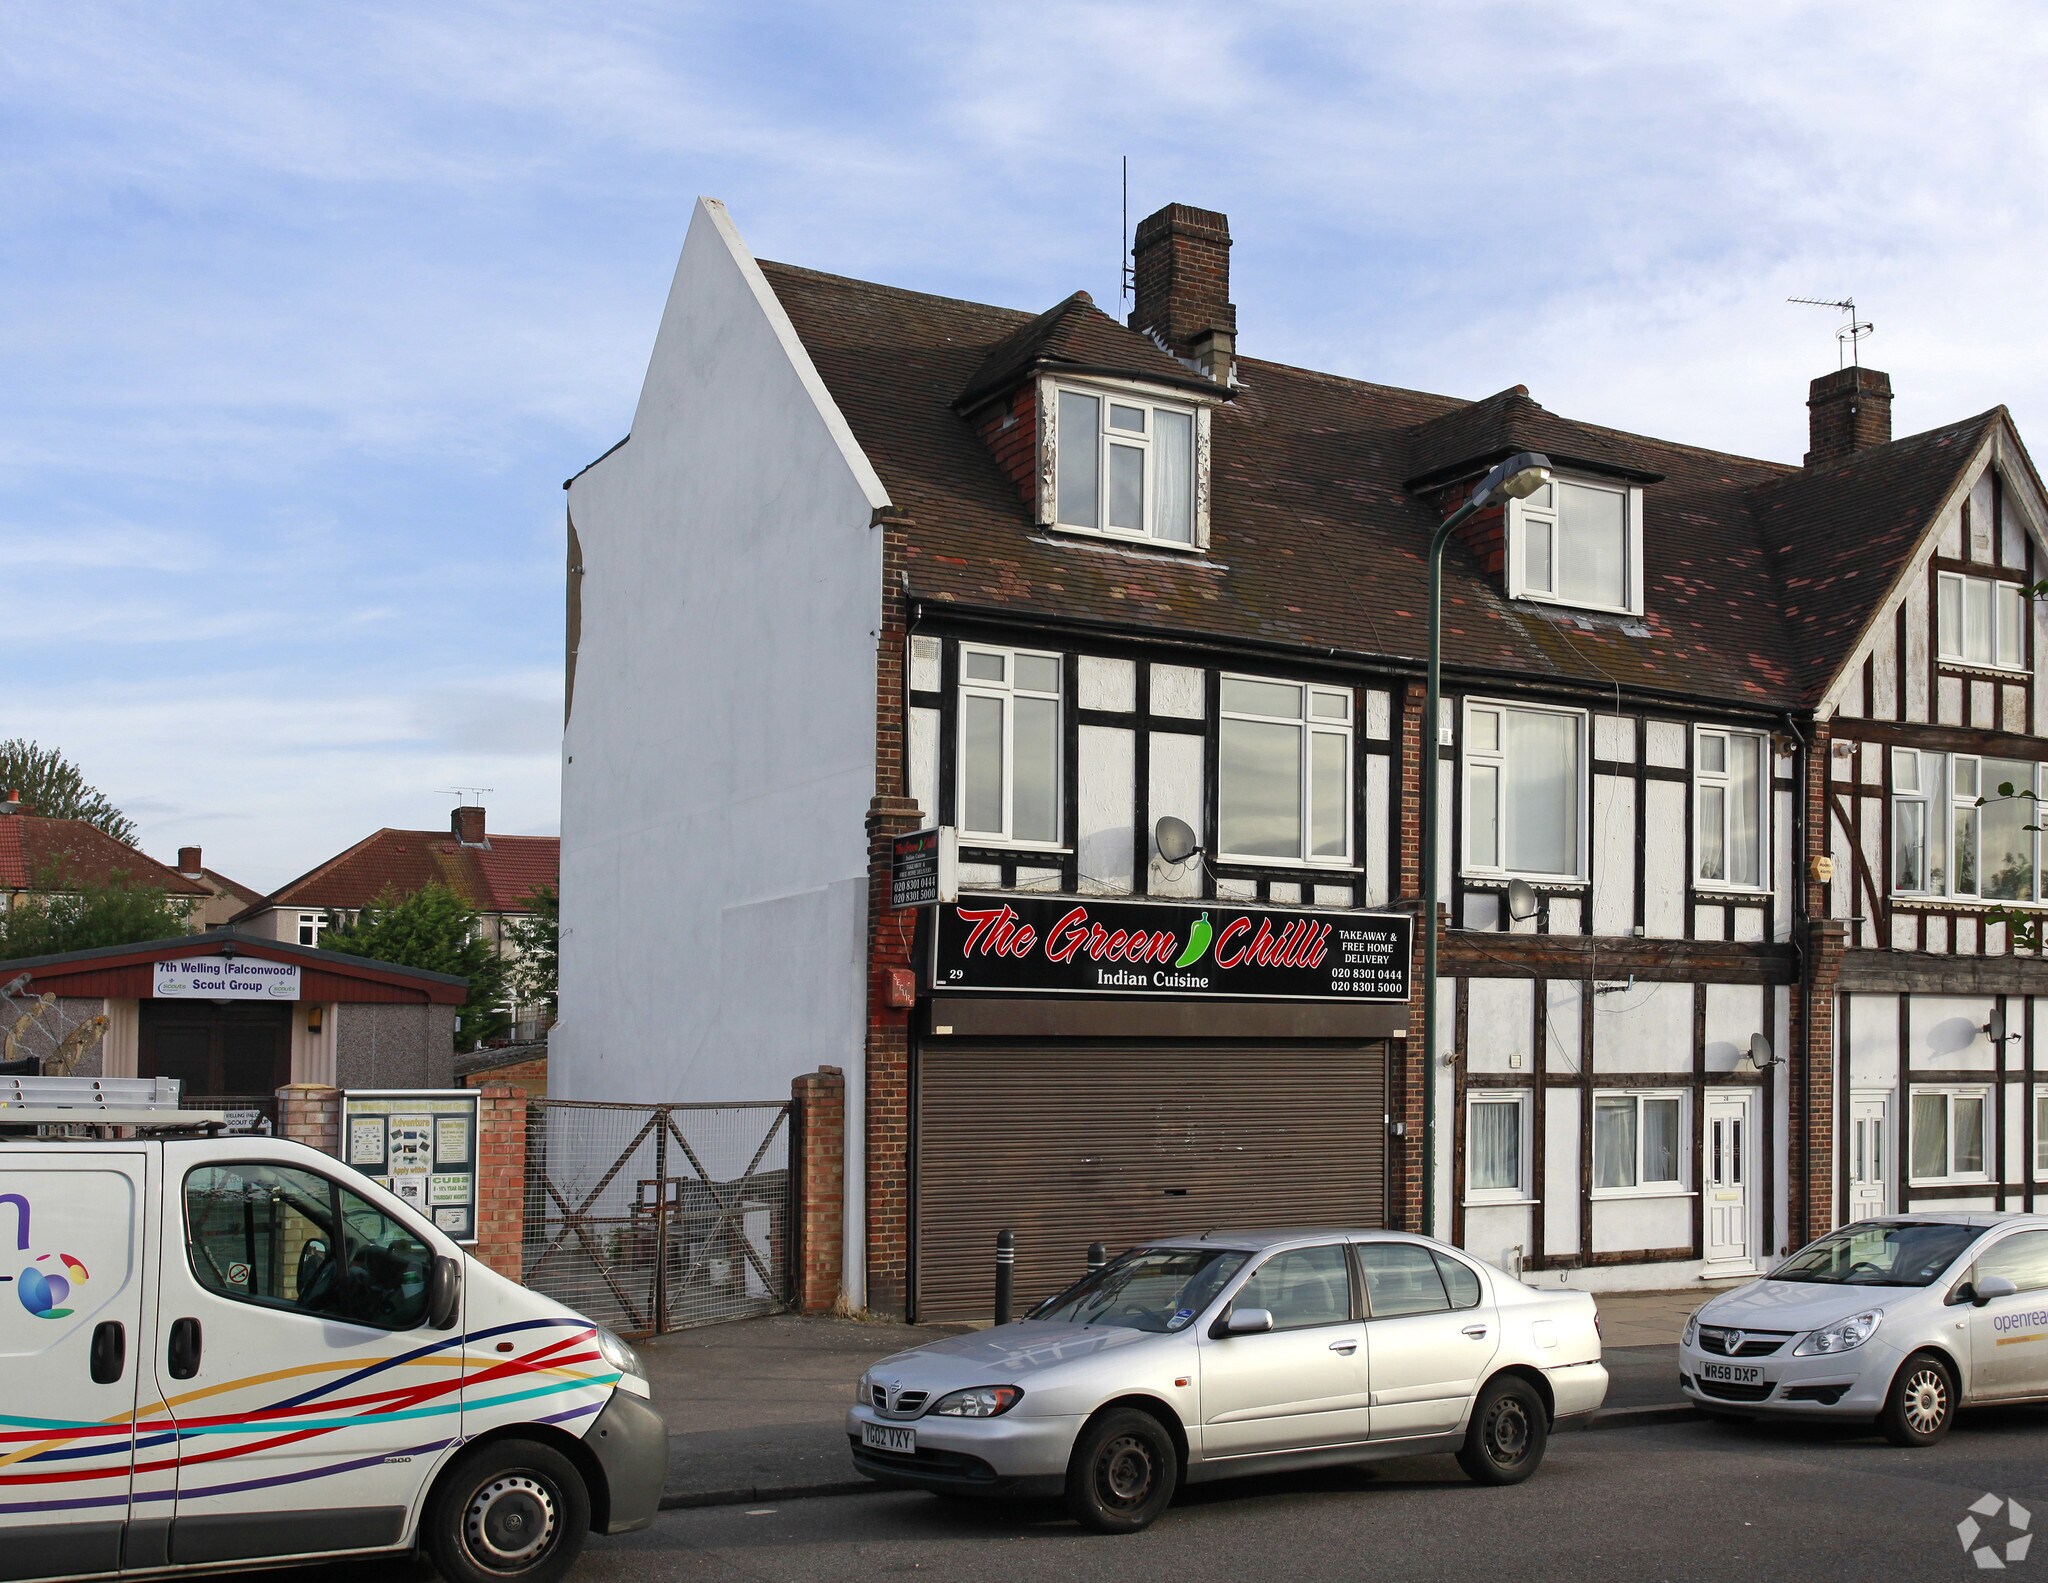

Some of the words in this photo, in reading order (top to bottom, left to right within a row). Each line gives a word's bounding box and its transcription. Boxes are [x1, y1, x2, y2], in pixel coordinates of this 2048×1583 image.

[894, 882, 905, 892] 020
[906, 879, 920, 890] 8301
[920, 876, 936, 887] 0444
[894, 893, 905, 903] 020
[906, 890, 919, 901] 8301
[920, 888, 936, 899] 5000
[956, 904, 1037, 958] The
[1045, 906, 1178, 964] Green
[1214, 916, 1332, 969] Chilli
[1339, 930, 1387, 942] TAKEAWAY
[1389, 932, 1398, 942] &
[1342, 942, 1364, 952] FREE
[1367, 943, 1394, 953] HOME
[1344, 954, 1390, 965] DELIVERY
[159, 962, 177, 973] 7th
[181, 962, 220, 975] Welling
[224, 962, 296, 977] (Falconwood)
[949, 969, 964, 979] 29
[1331, 967, 1350, 978] 020
[1352, 968, 1376, 979] 8301
[1377, 969, 1402, 980] 0444
[1097, 968, 1148, 986] Indian
[1153, 970, 1209, 988] Cuisine
[192, 979, 225, 990] Scout
[229, 980, 263, 992] Group
[893, 973, 914, 1006] SECURE
[1331, 981, 1350, 991] 020
[1352, 981, 1376, 992] 8301
[1377, 982, 1402, 993] 5000
[392, 1118, 430, 1127] Adventure
[393, 1167, 410, 1175] Apply
[411, 1166, 427, 1174] within
[432, 1176, 470, 1184] CUBS
[1994, 1311, 2048, 1333] openrea
[1705, 1364, 1731, 1380] WR58
[1734, 1367, 1758, 1382] DXP
[865, 1424, 886, 1446] YG02
[888, 1429, 910, 1449] VXY
